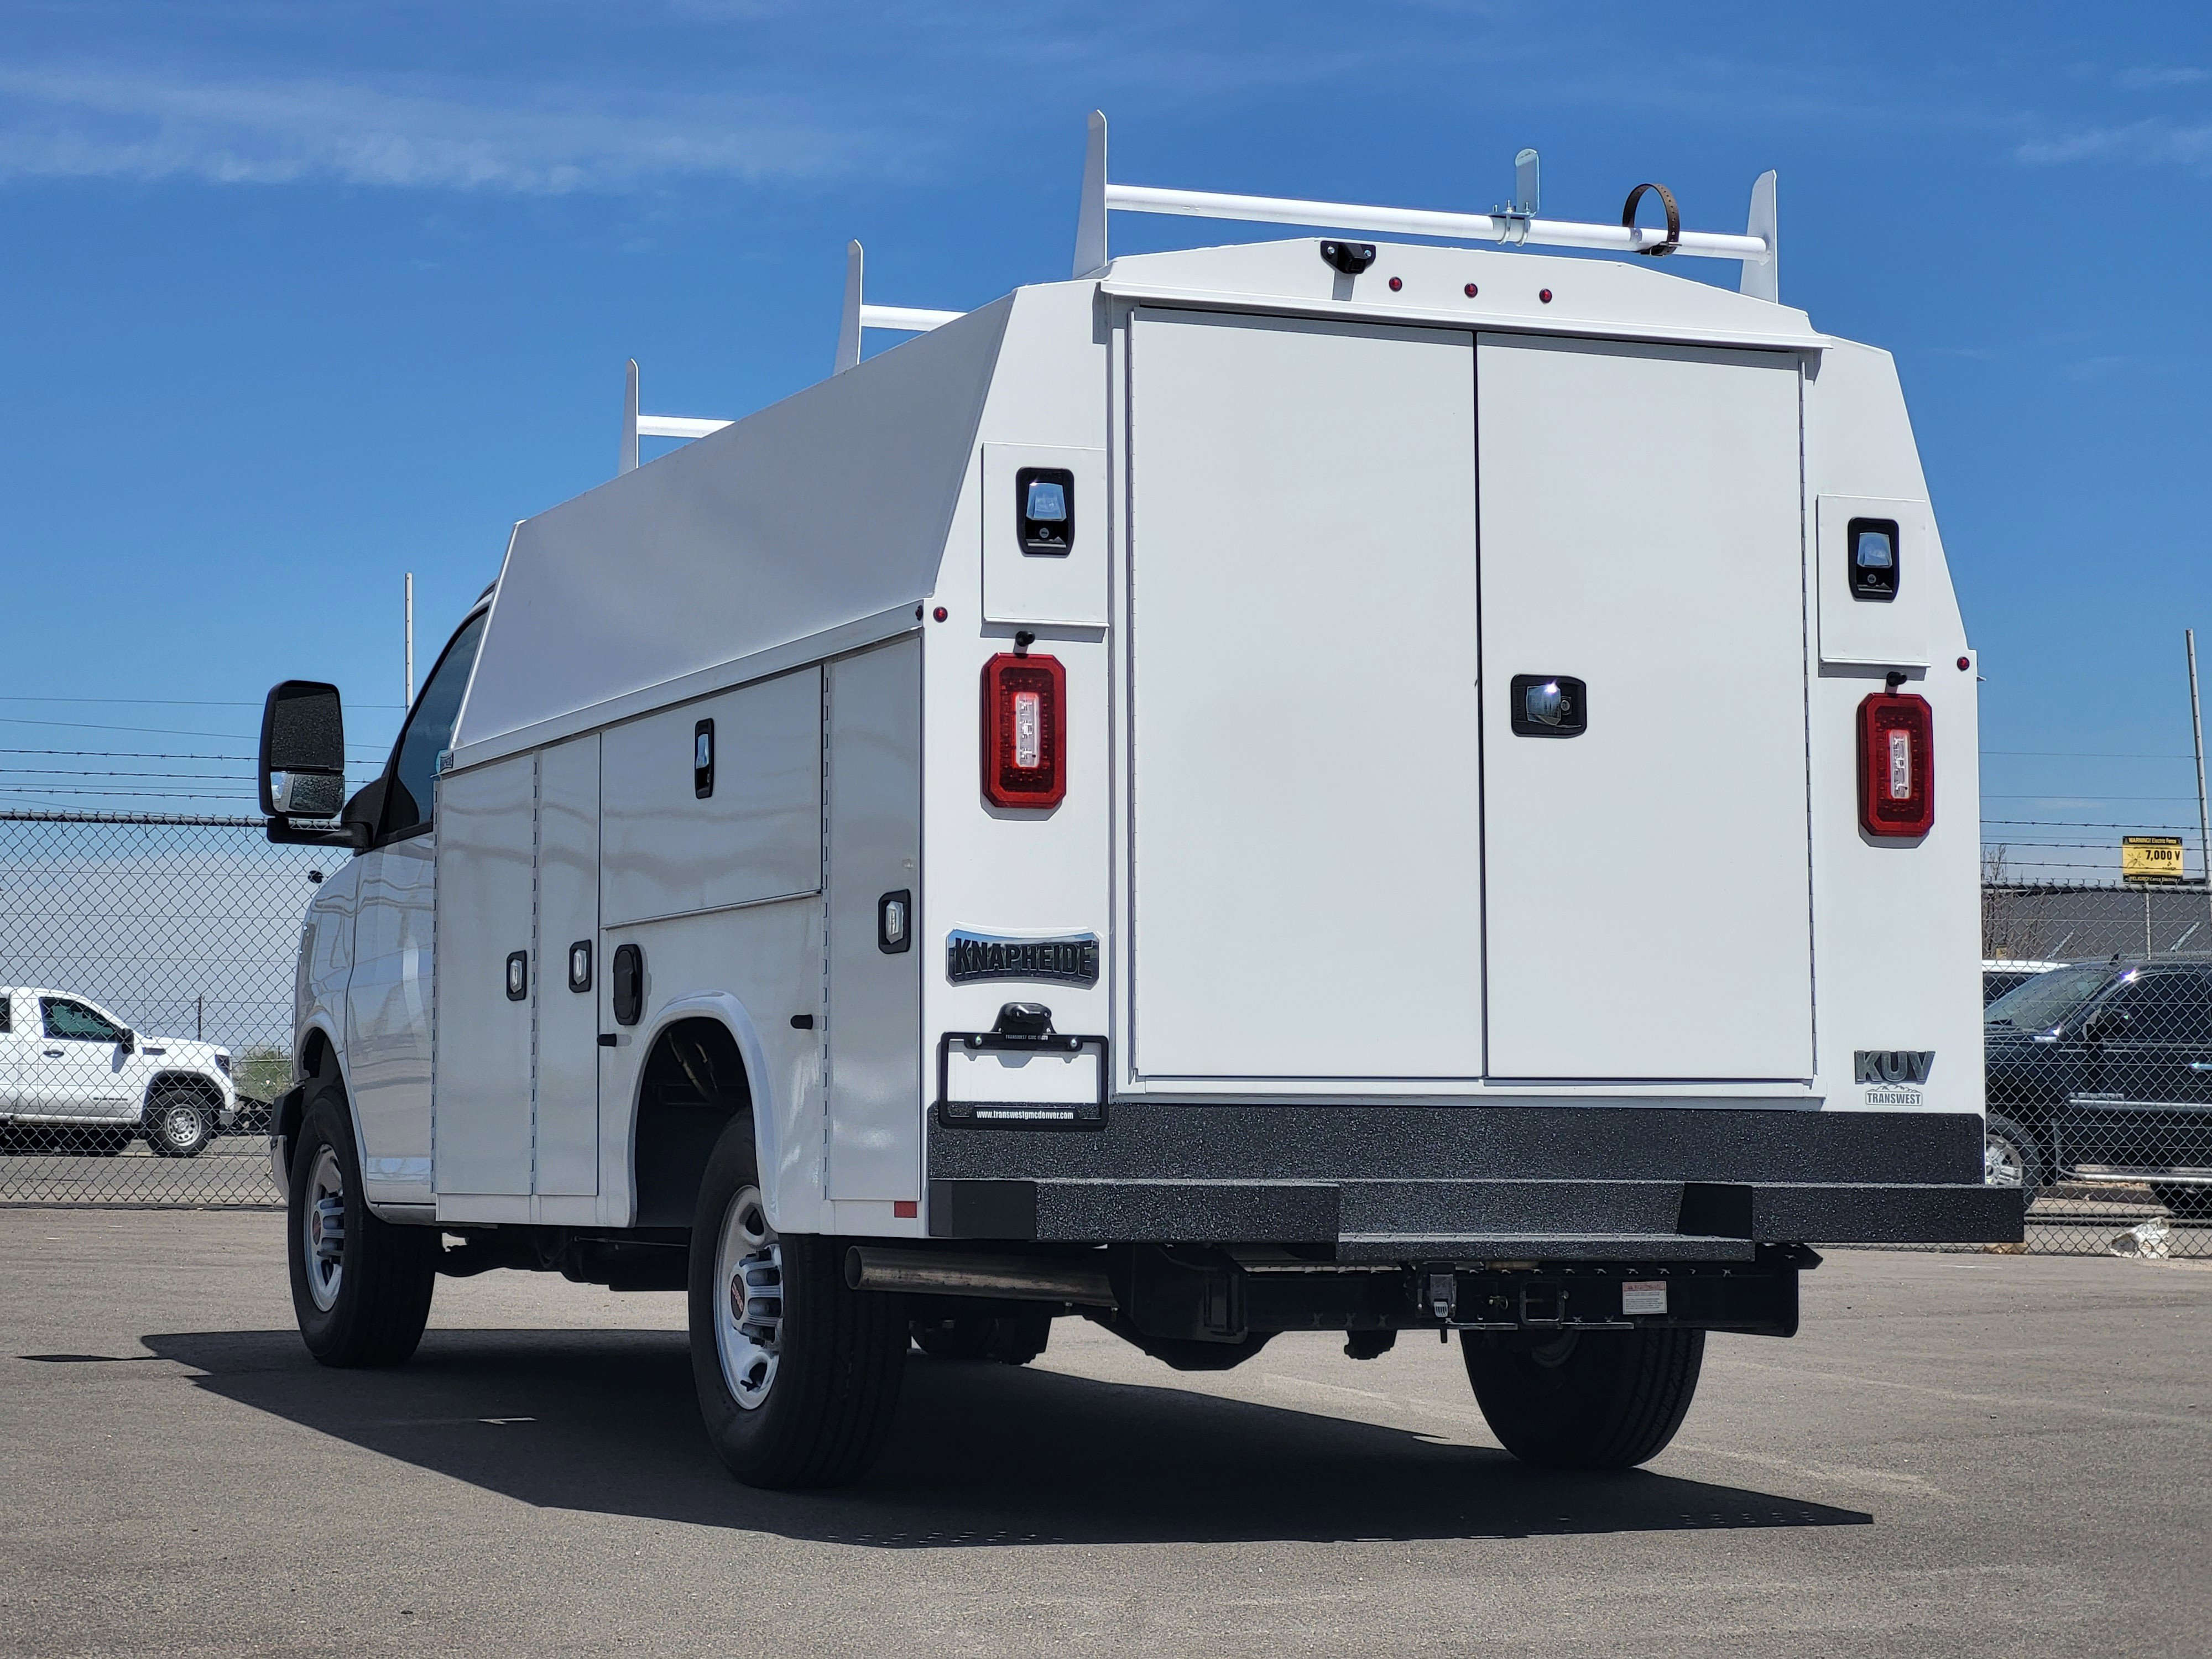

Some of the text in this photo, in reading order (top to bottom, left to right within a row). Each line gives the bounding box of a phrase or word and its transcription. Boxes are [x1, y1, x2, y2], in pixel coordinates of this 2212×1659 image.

[2146, 850, 2180, 861] 7,000 V
[954, 937, 1094, 978] KNAPHEIDE
[1854, 1050, 1936, 1082] KUV
[1867, 1093, 1921, 1104] TRANSWEST
[976, 1110, 1074, 1120] www.transwestgmcdenver.com
